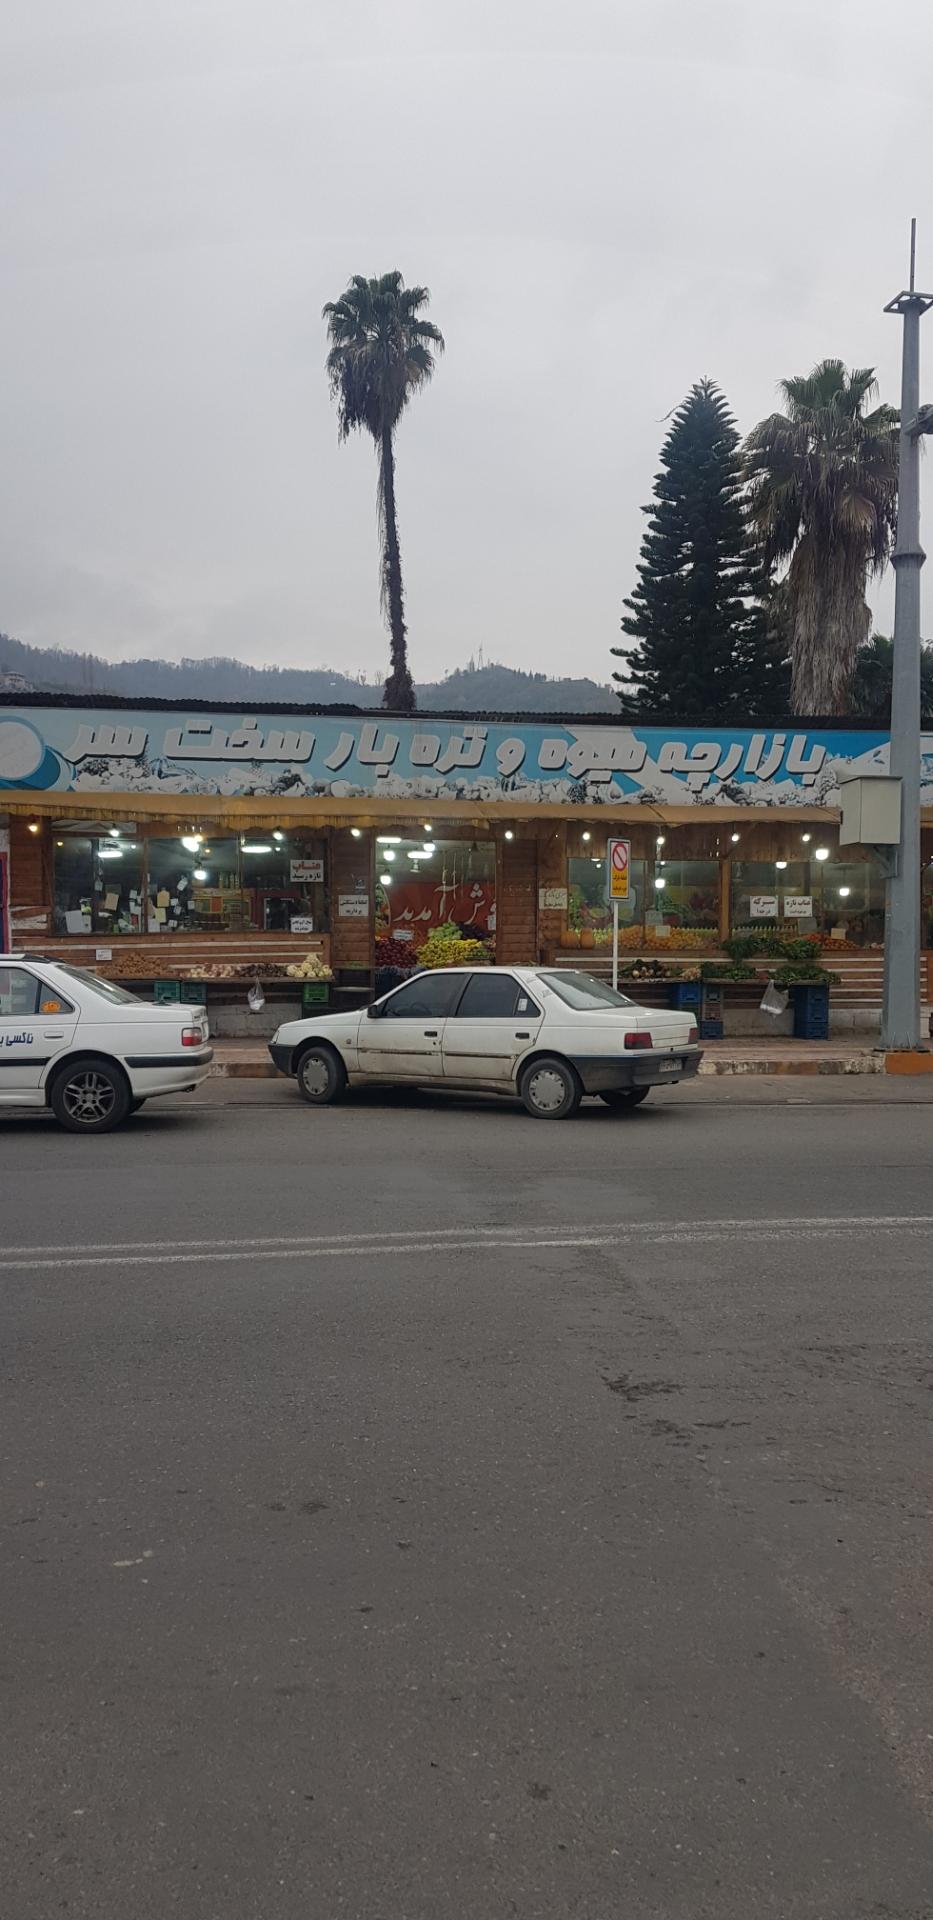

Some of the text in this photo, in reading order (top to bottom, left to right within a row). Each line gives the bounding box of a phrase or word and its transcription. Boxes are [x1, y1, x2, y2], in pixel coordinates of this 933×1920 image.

[61, 717, 827, 793] بازارچه میوه و تره بار سخت سر
[292, 871, 321, 881] تازه رسید
[393, 884, 459, 922] آمدید
[753, 897, 775, 907] سرکه
[786, 899, 797, 908] تازه
[5, 1031, 34, 1047] تاکسی
